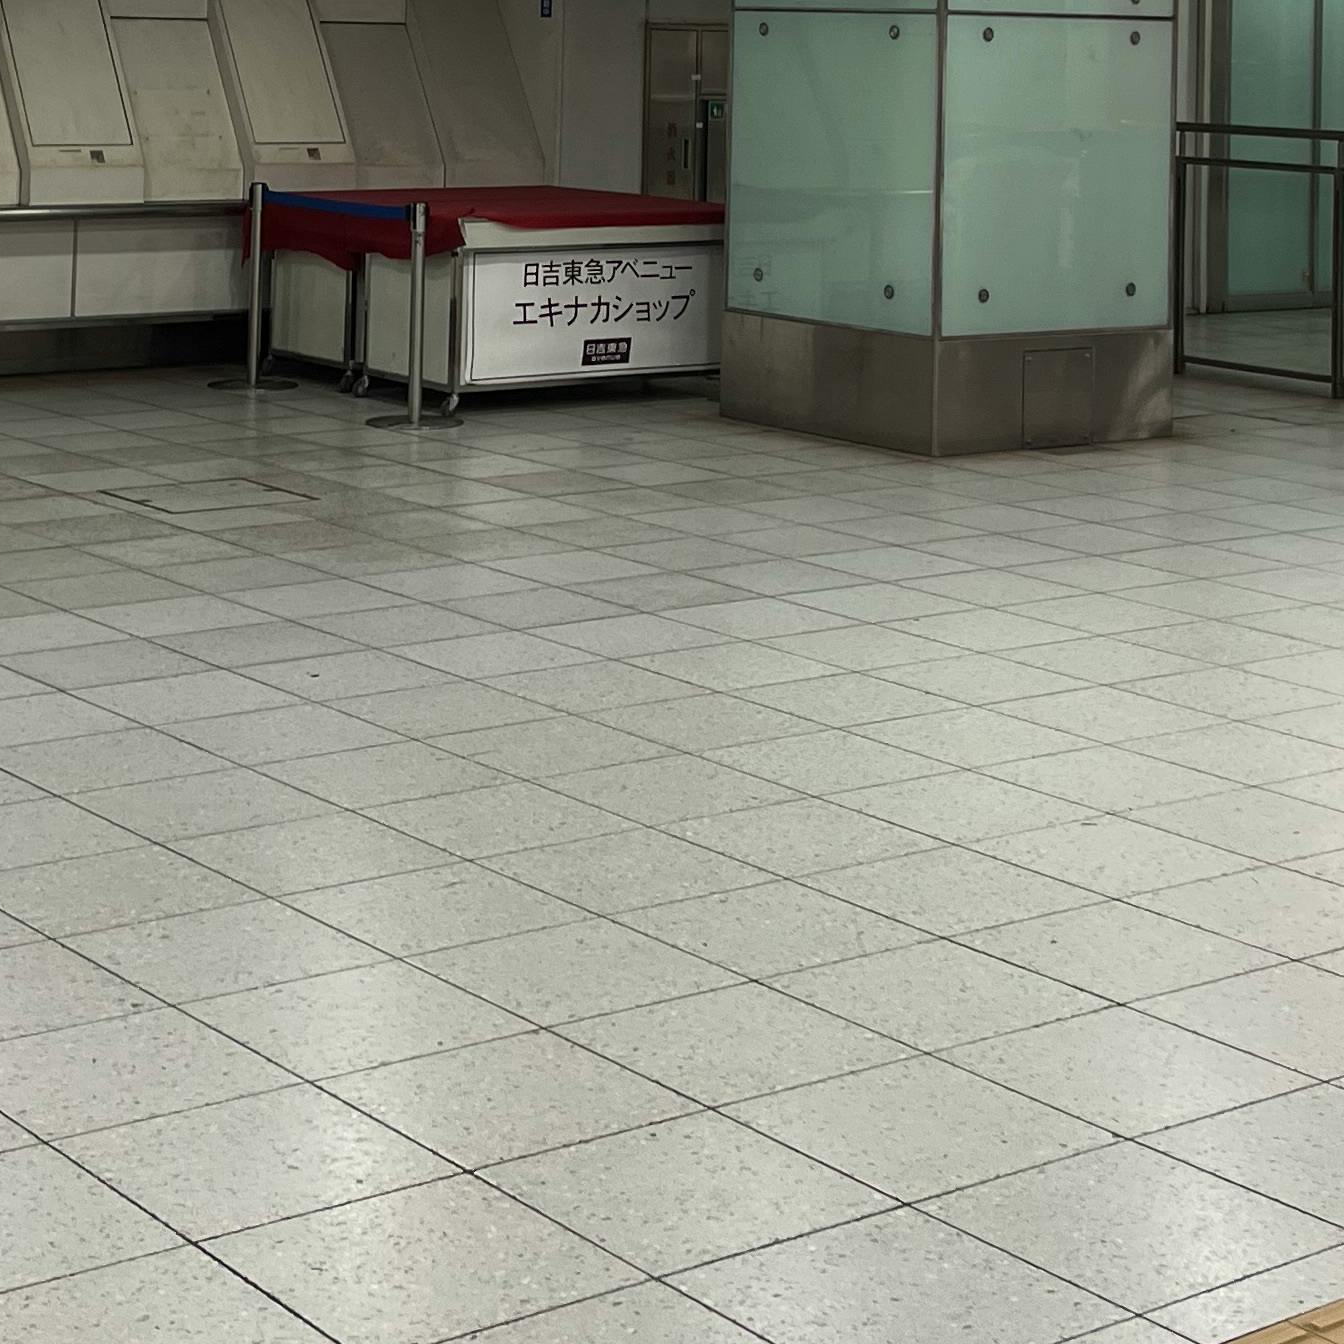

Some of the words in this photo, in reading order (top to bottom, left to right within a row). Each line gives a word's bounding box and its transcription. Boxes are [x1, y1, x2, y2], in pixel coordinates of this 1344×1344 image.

[523, 258, 693, 287] 日吉東急アベニュー
[513, 289, 696, 327] エキナカショップ
